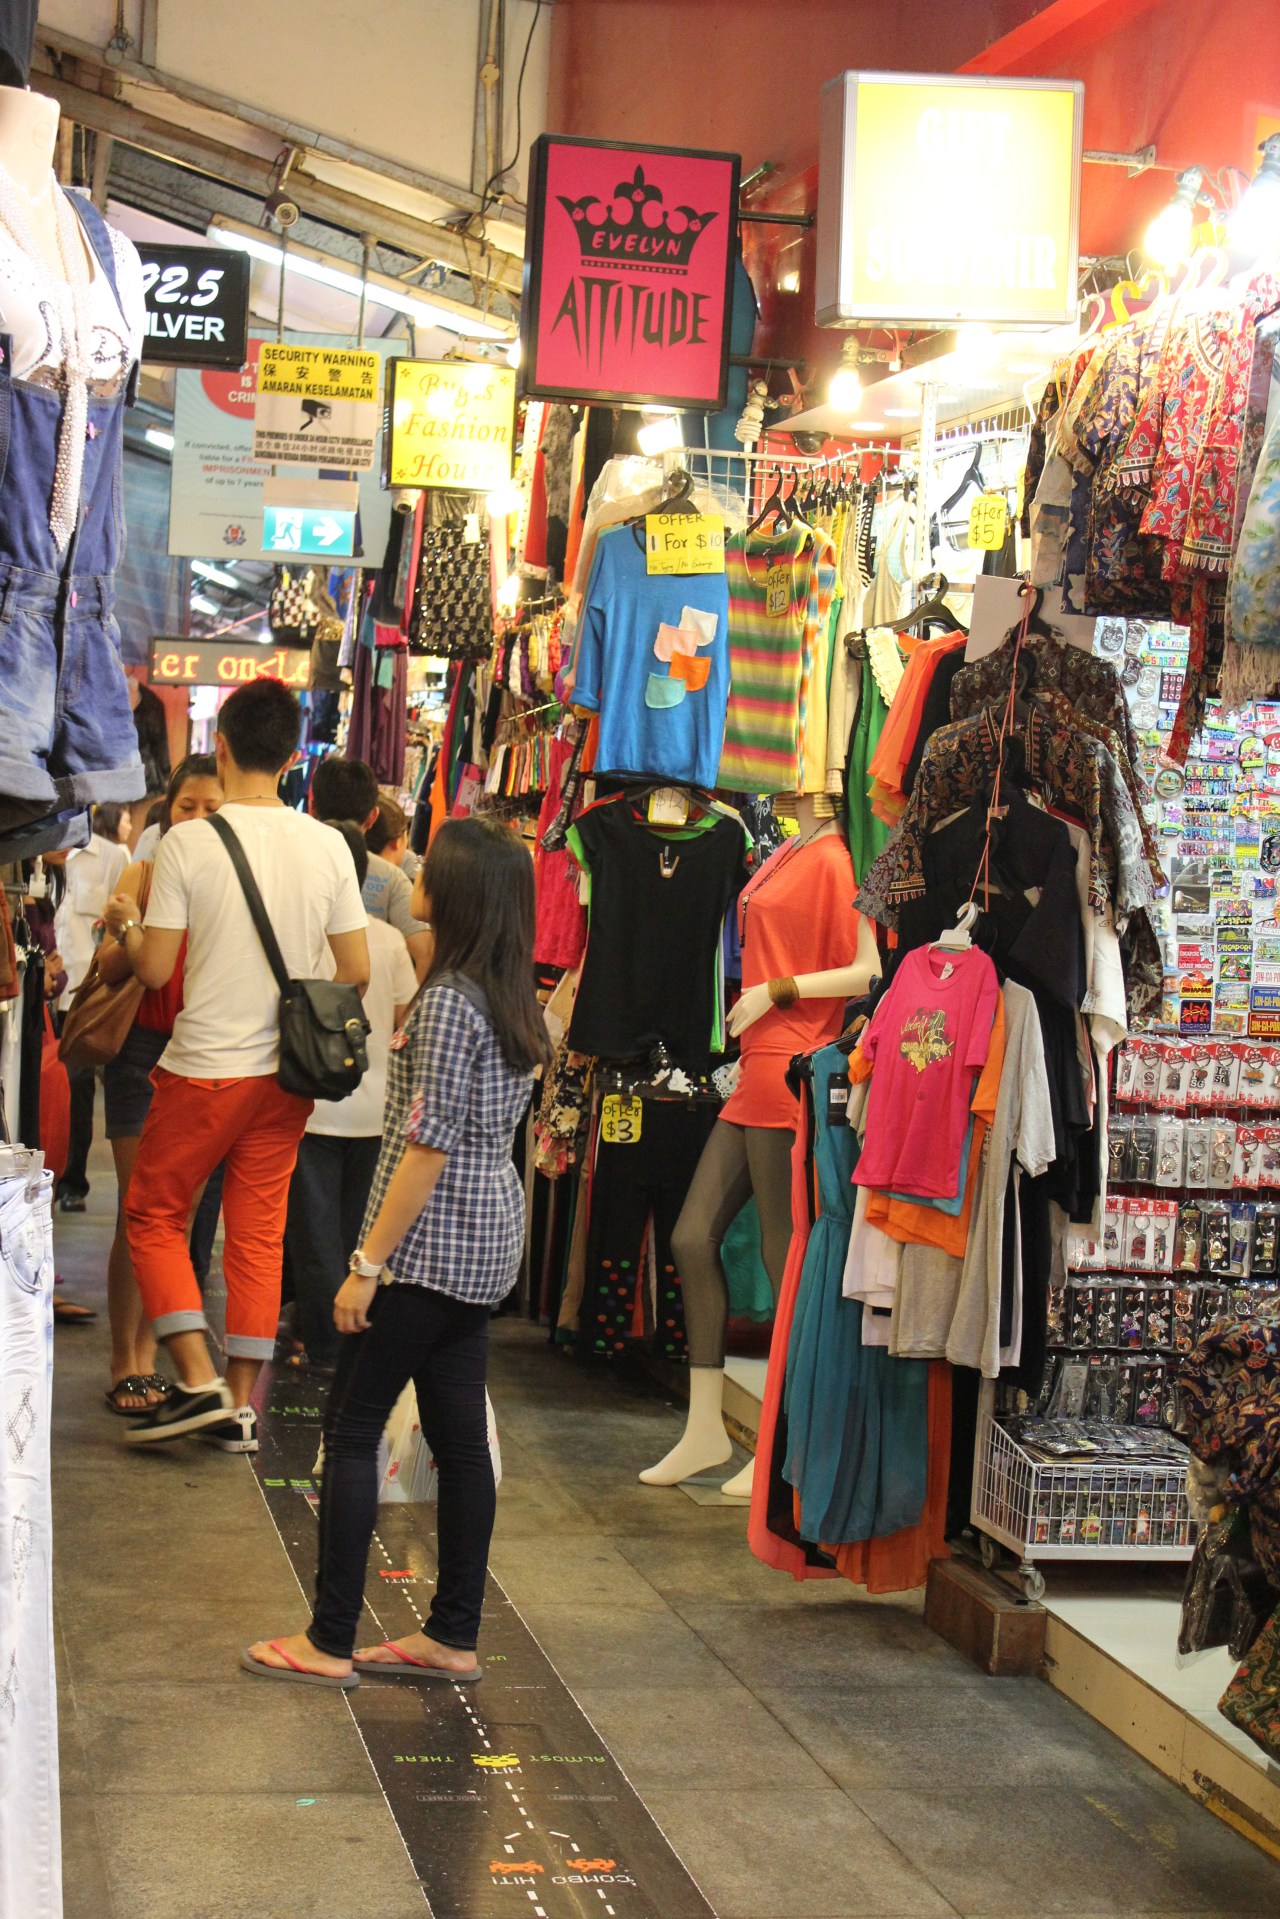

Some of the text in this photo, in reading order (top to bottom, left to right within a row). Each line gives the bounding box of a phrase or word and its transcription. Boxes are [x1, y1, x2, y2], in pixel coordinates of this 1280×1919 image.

[591, 231, 682, 256] EVELYN
[144, 311, 226, 342] ILVER
[551, 275, 713, 376] ATTITUDE
[264, 349, 375, 368] SECURITY WARNING
[262, 381, 373, 399] AMARAN KESELAMATAN
[402, 413, 508, 442] Fashion
[659, 513, 705, 526] OFFER
[971, 503, 1004, 521] offer
[664, 532, 688, 550] For
[972, 524, 995, 544] $5
[767, 568, 791, 590] offer
[1190, 1079, 1206, 1089] SG
[606, 1119, 634, 1142] $3
[238, 1412, 253, 1420] NIKE
[392, 1754, 606, 1764] ALMOST THERE
[483, 1766, 523, 1775] HIT!
[491, 1874, 633, 1885] COMBO HIT!
